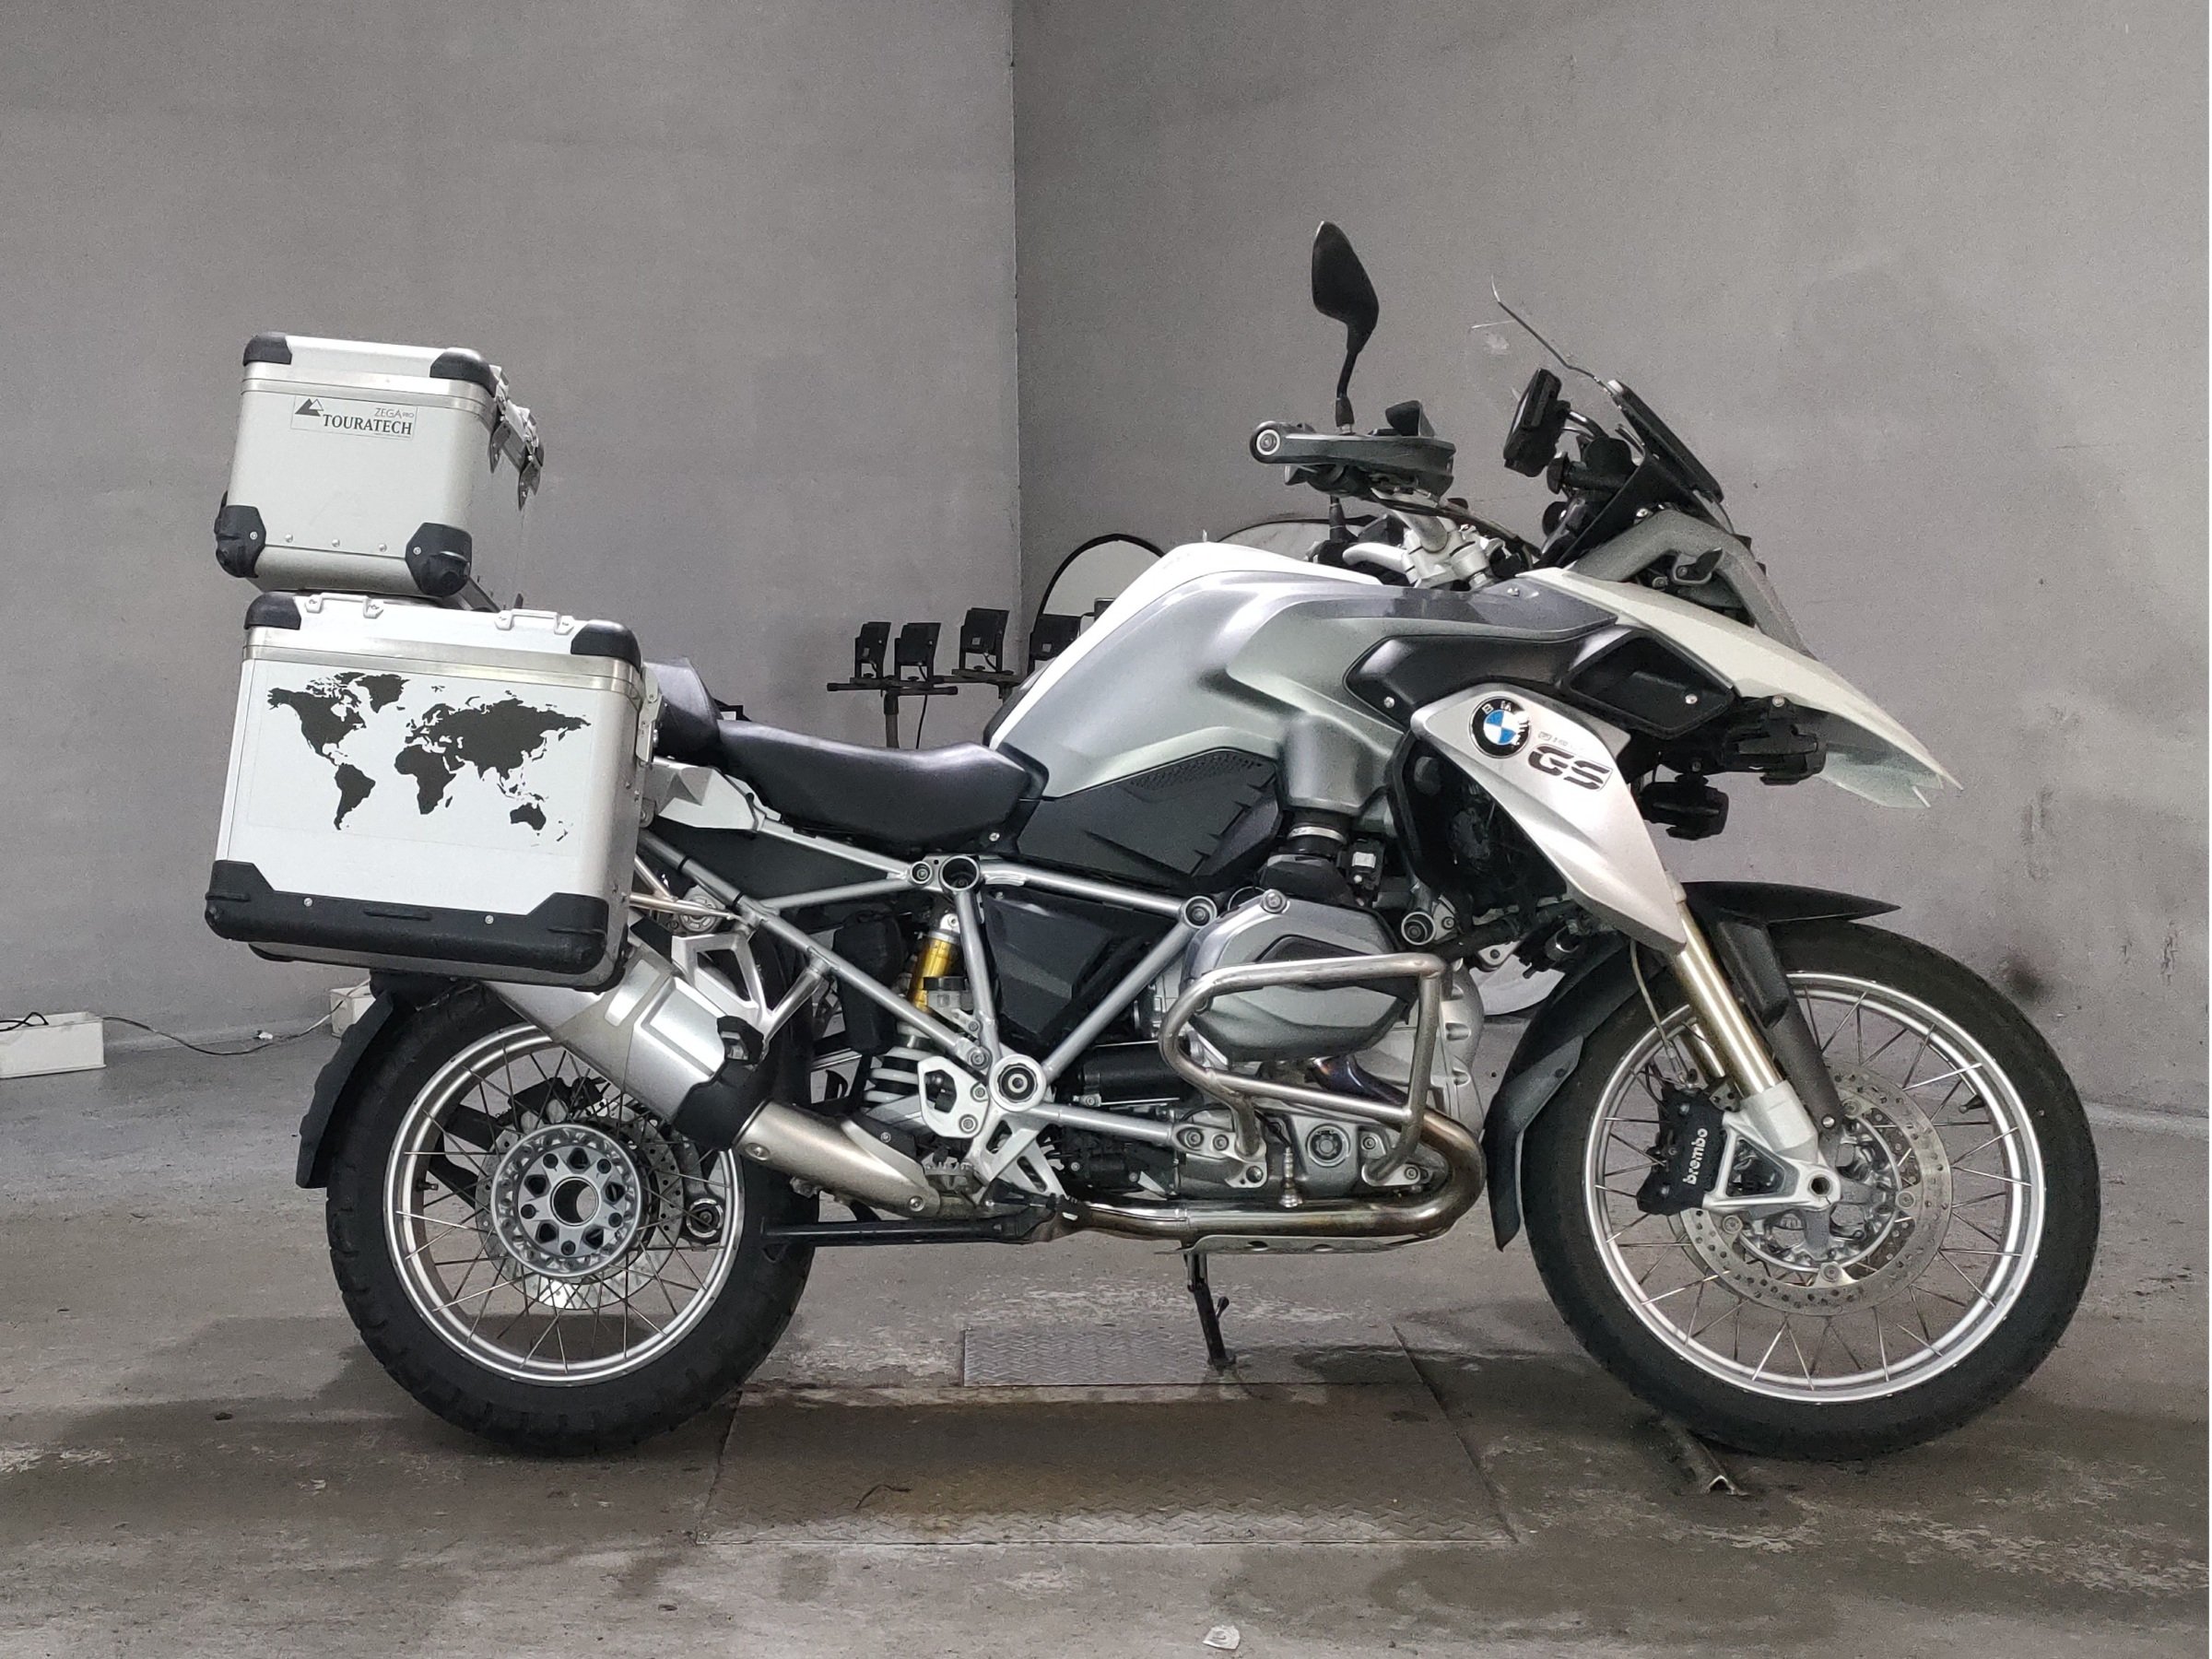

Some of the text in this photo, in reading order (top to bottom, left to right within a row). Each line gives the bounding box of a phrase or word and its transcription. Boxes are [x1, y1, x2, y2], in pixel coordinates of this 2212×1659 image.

[323, 414, 413, 435] TOURATECH
[374, 407, 403, 419] ZEGA
[1528, 744, 1611, 791] GS
[1682, 1127, 1708, 1185] brembo
